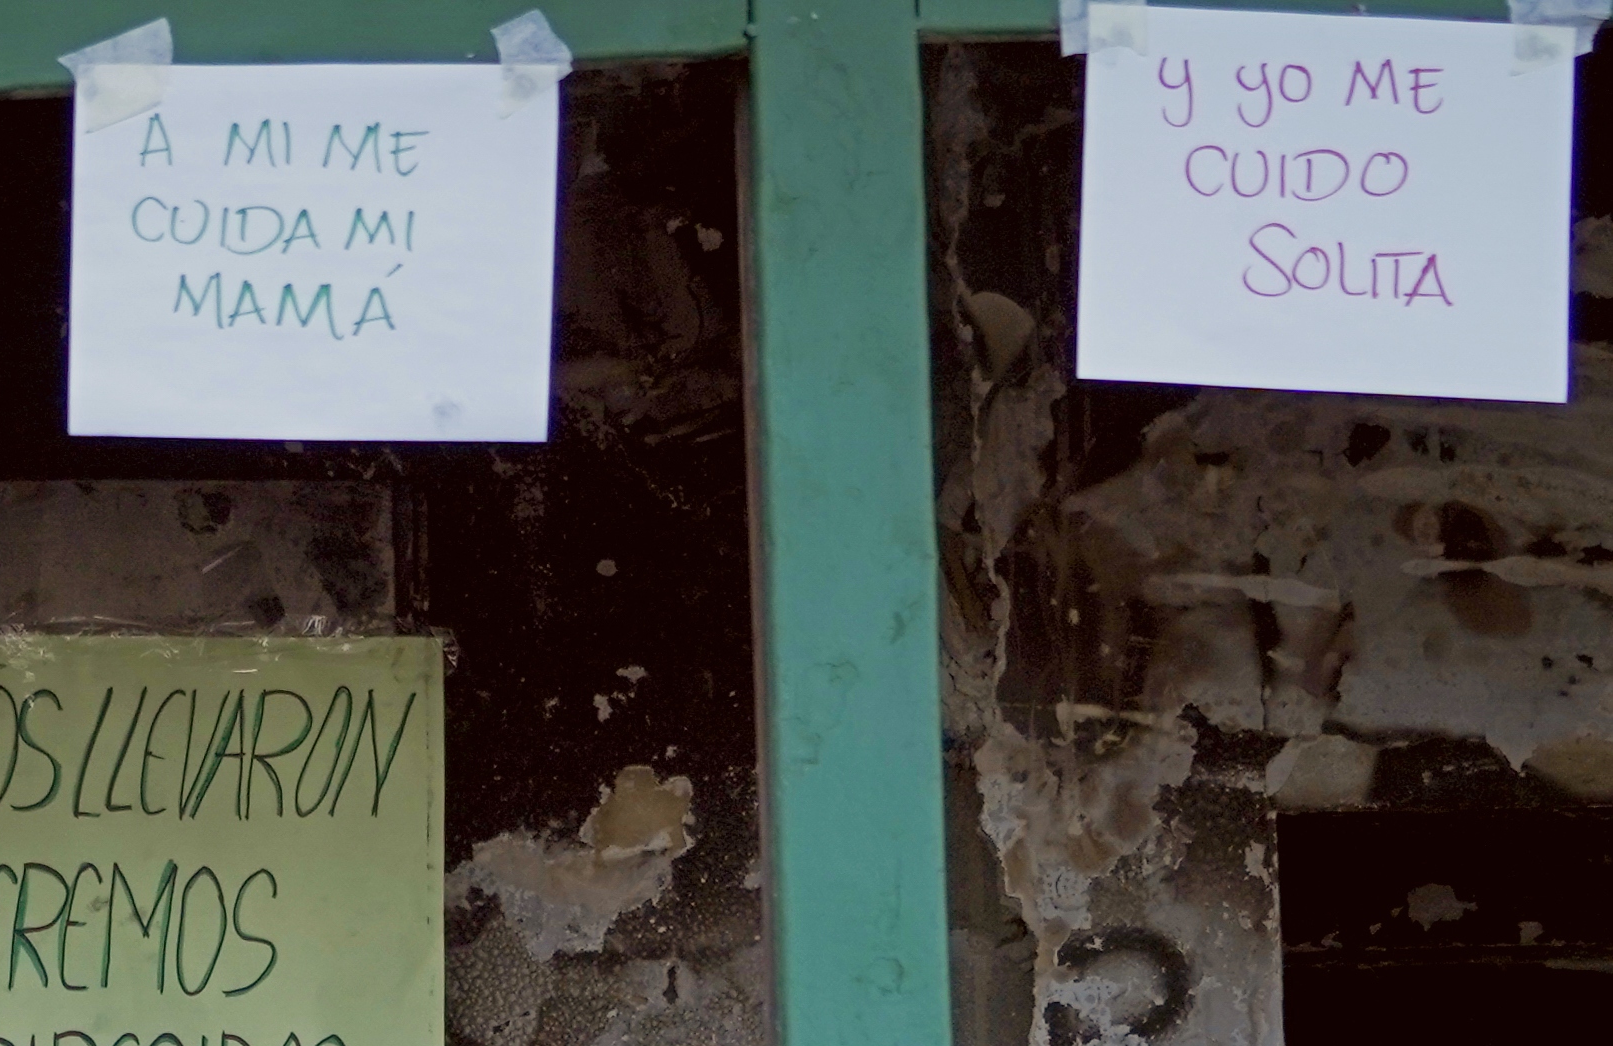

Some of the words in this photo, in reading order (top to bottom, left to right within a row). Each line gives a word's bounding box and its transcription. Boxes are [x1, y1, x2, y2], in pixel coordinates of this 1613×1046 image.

[1346, 59, 1445, 114] ME
[140, 113, 172, 167] A
[224, 118, 291, 168] MI
[323, 121, 430, 177] ME
[1186, 145, 1409, 202] CUIDO
[132, 196, 321, 256] CUIDA
[344, 208, 415, 251] MI
[1243, 222, 1454, 307] SOLITA
[174, 263, 404, 341] MAMÁ
[73, 685, 417, 821] LLEVARON
